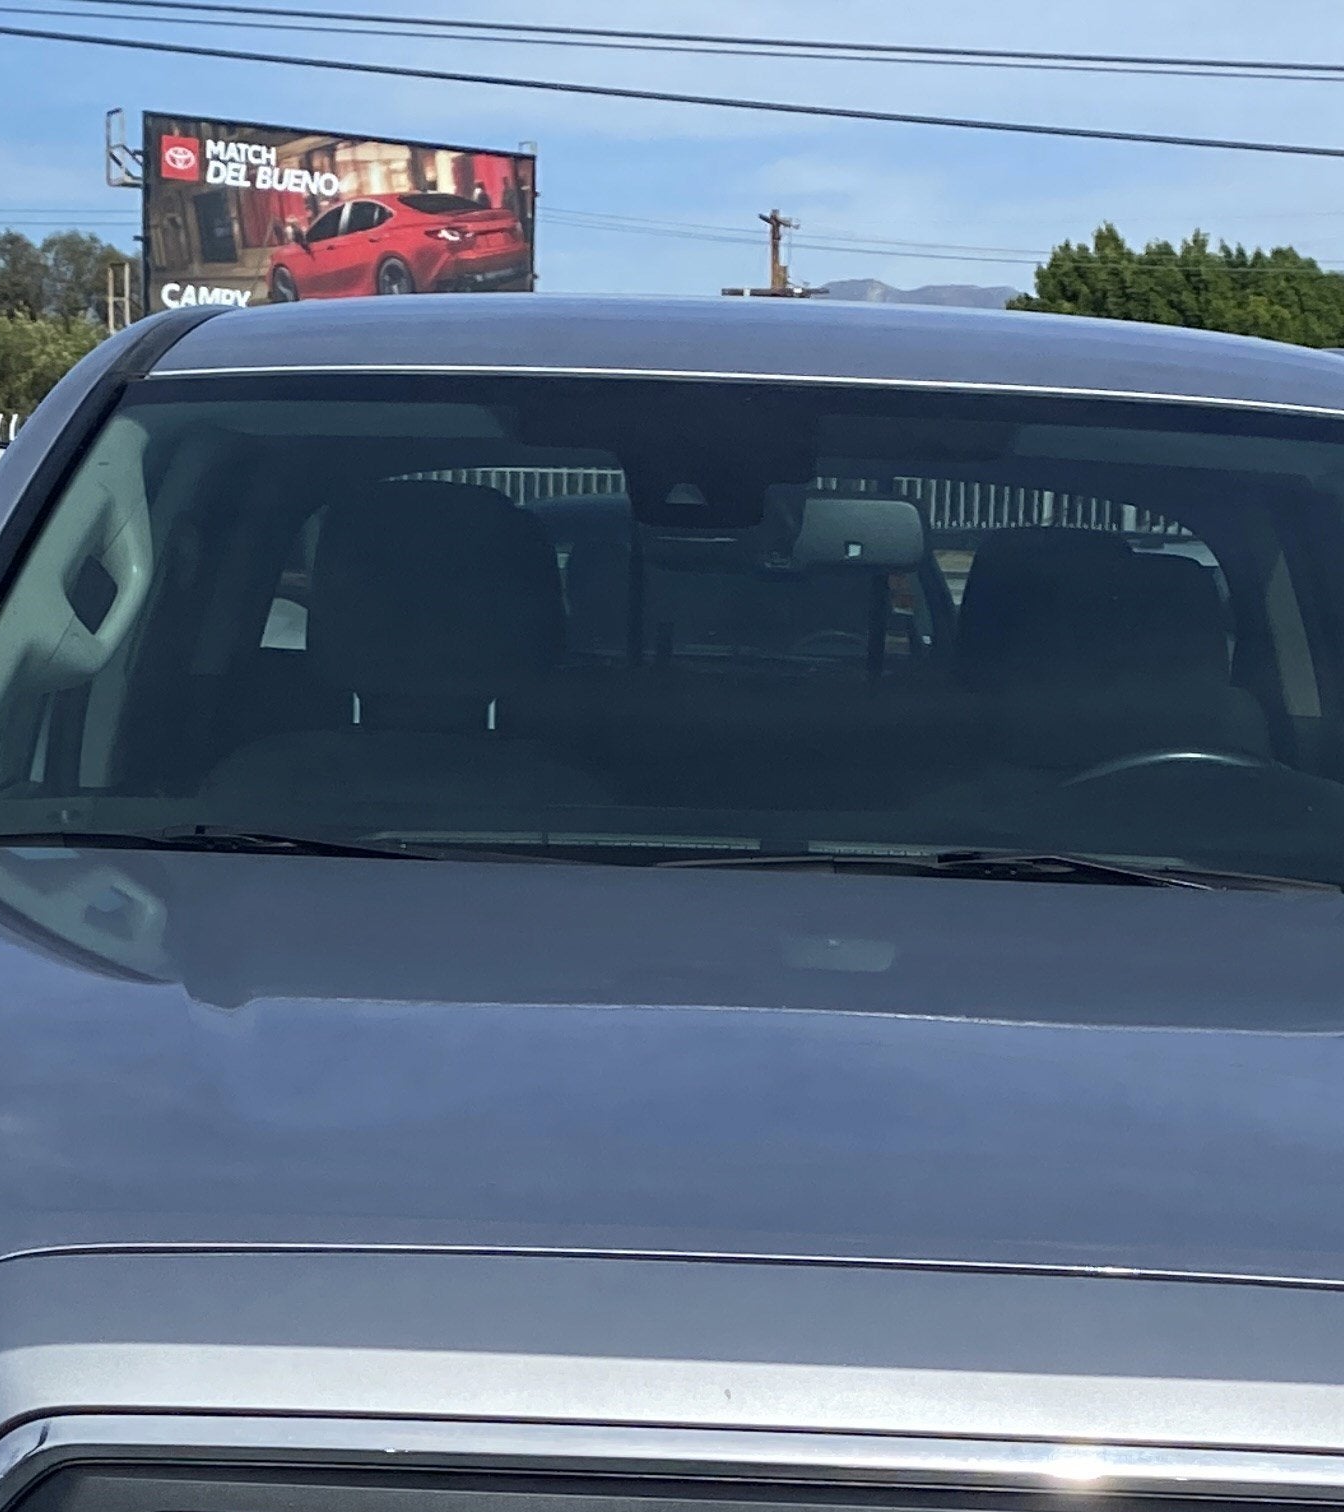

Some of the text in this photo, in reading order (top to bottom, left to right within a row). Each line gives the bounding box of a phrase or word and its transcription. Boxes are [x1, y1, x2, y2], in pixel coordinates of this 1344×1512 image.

[206, 140, 276, 166] MATCH
[206, 161, 339, 196] DEL BUENO
